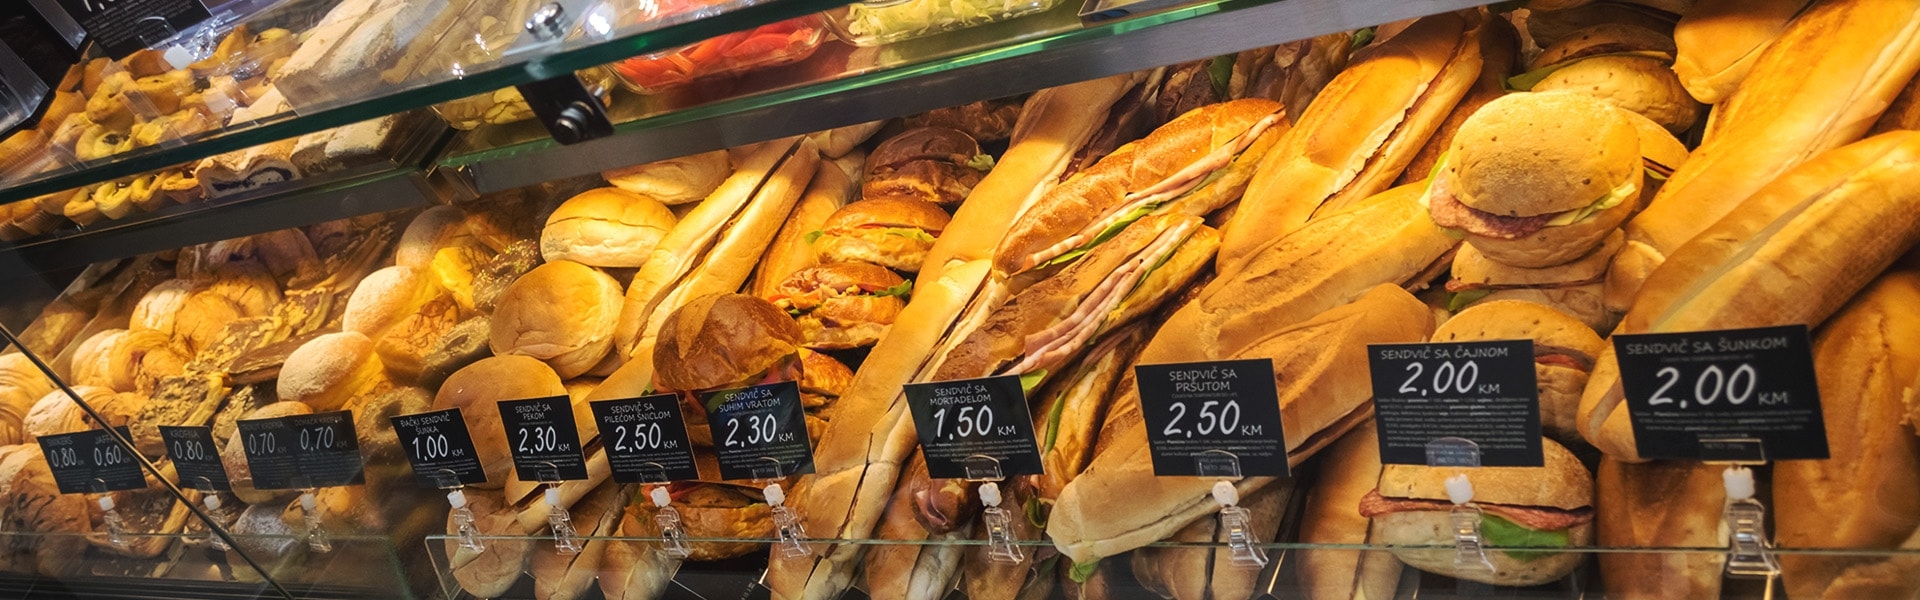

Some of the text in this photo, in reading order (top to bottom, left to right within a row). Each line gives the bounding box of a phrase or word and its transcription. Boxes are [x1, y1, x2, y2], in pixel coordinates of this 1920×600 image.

[1625, 337, 1788, 355] SENDVIČ SA ŠUNKOM
[1381, 345, 1509, 360] SENDVIČ SA ČAJNOM
[1169, 366, 1237, 382] SENDVIČ SA
[934, 384, 988, 397] SENDVIČ SA
[1176, 378, 1230, 392] PRŠUTOM
[1478, 383, 1500, 394] KM
[724, 388, 773, 402] SENDVIČ SA
[929, 394, 991, 405] MORTADELOM
[1757, 391, 1788, 405] KM
[515, 403, 552, 414] SENDVIČ SA
[610, 402, 655, 414] SENDVIČ SA
[719, 403, 744, 413] SUHIM
[745, 398, 781, 409] VRATOM
[422, 412, 450, 425] SENDVIČ
[523, 412, 545, 420] PEKOM
[415, 426, 439, 435] ŠUNKA
[997, 425, 1017, 436] KM
[1241, 424, 1263, 436] KM
[778, 432, 794, 442] KM
[558, 443, 571, 451] KM
[663, 440, 678, 449] KM
[451, 448, 464, 457] KM
